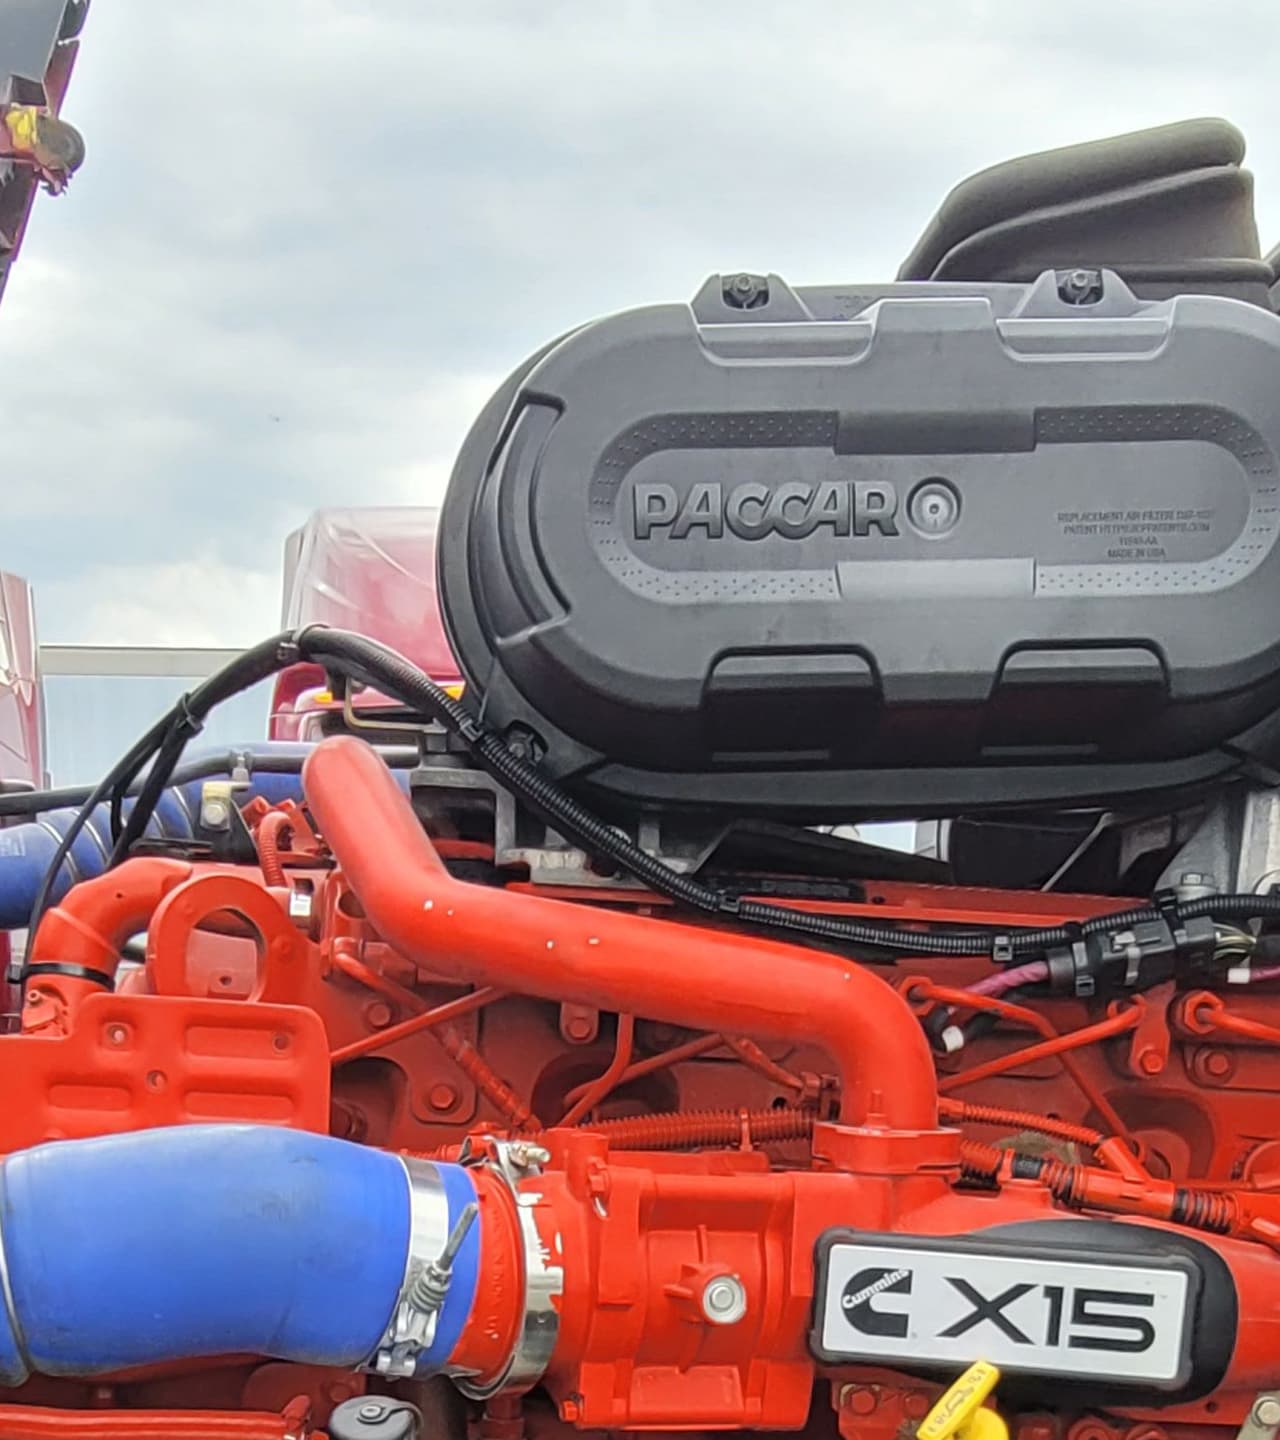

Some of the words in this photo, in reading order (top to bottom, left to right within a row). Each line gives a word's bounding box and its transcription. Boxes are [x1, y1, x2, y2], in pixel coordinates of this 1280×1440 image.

[632, 480, 900, 541] PACCAR
[841, 1267, 910, 1309] Cummins
[936, 1276, 1156, 1354] X15
